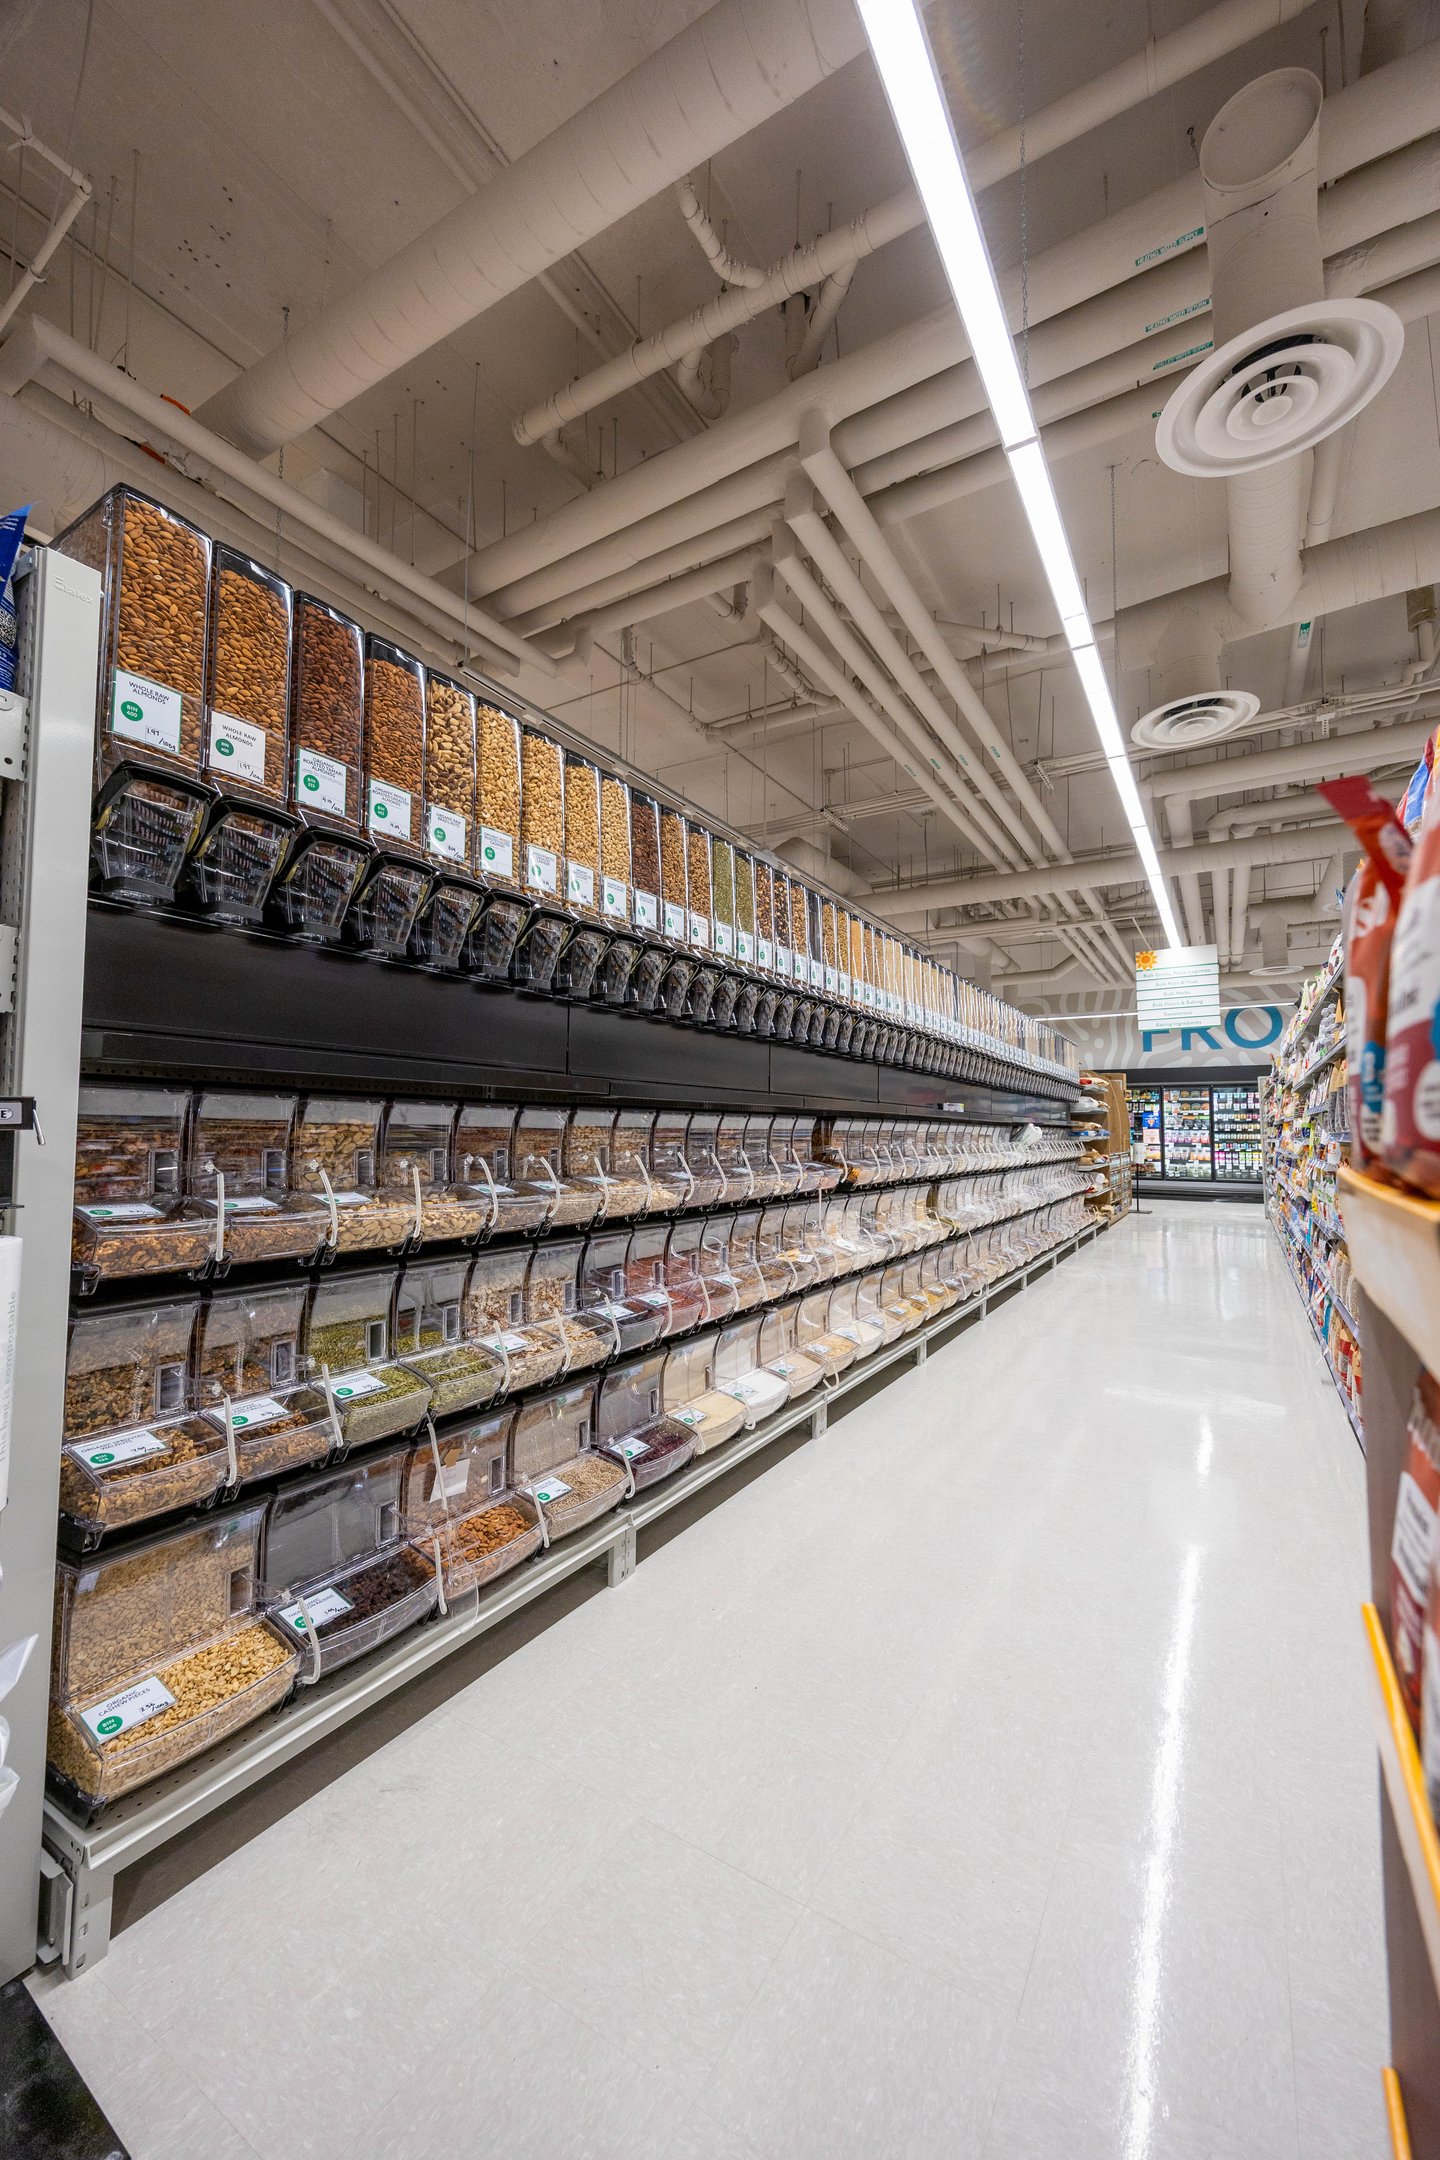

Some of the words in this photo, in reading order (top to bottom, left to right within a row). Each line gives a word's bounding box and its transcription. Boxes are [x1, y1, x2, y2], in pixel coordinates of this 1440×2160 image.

[129, 681, 153, 696] WHOLE
[154, 692, 170, 702] RAW
[132, 688, 166, 705] ALMONDS
[126, 704, 138, 712] BIN
[222, 724, 242, 736] WHOLE
[243, 733, 257, 742] RAW
[225, 732, 253, 747] ALMONDS
[5, 1291, 17, 1385] compostable
[98, 1698, 128, 1717] CASHEW
[128, 1687, 151, 1702] PIECES
[106, 1689, 138, 1708] ORGANIC
[101, 1718, 115, 1728] BIN
